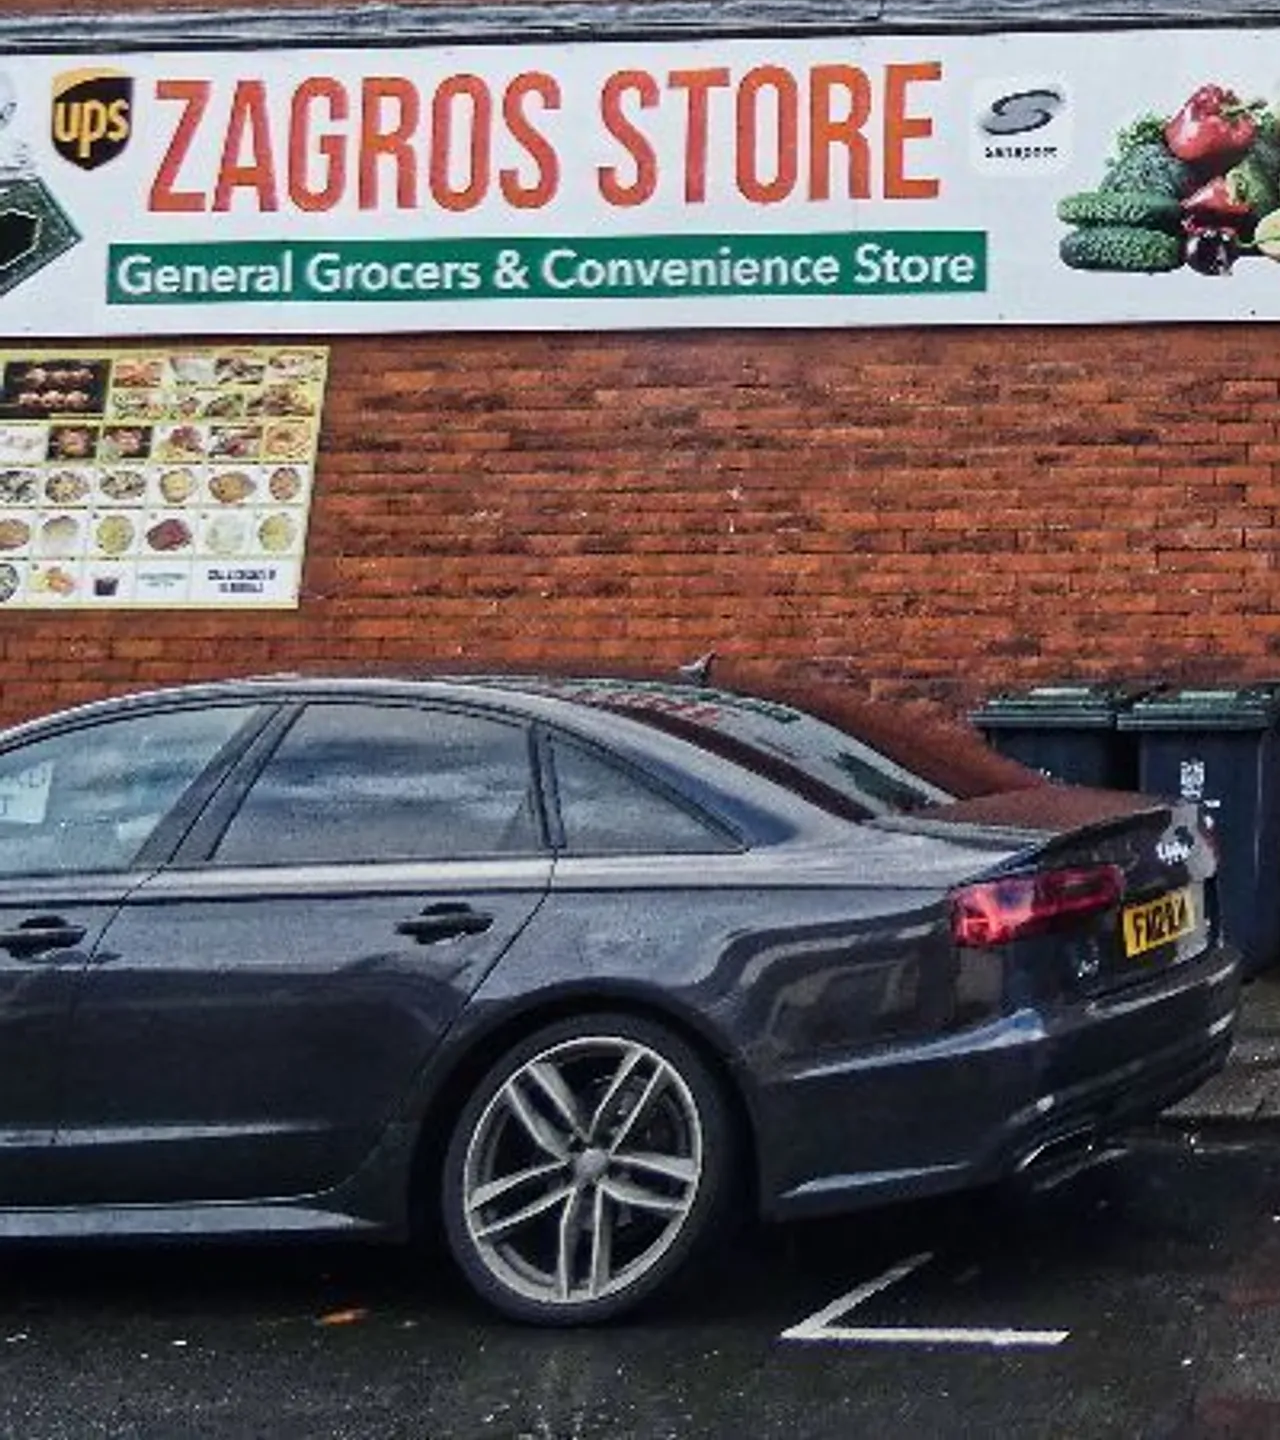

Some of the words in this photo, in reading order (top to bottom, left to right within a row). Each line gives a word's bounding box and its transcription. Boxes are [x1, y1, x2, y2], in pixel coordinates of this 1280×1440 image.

[55, 98, 129, 158] ups
[148, 72, 561, 212] ZAGROS
[597, 61, 943, 206] STORE
[117, 250, 293, 295] General
[306, 250, 482, 293] Grocers
[494, 248, 530, 290] &
[541, 245, 841, 290] Convenience
[854, 242, 975, 284] Store
